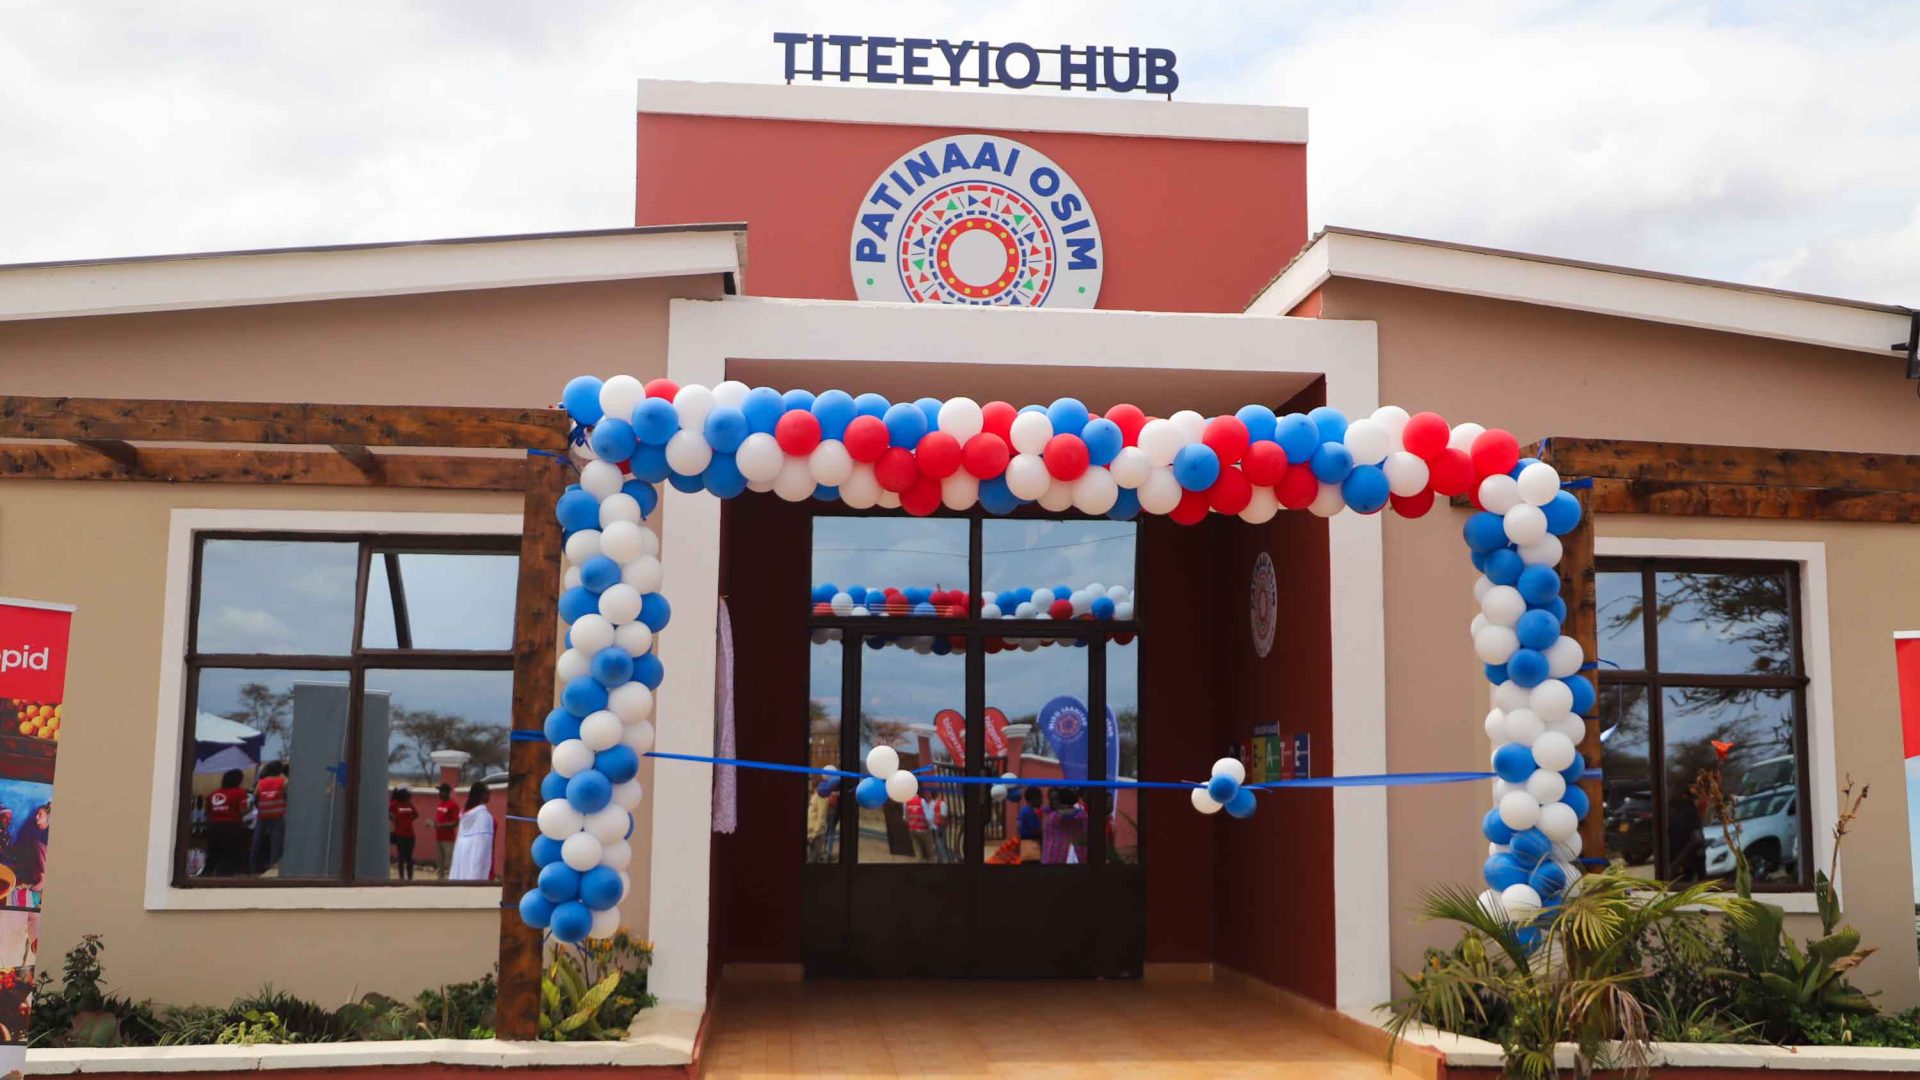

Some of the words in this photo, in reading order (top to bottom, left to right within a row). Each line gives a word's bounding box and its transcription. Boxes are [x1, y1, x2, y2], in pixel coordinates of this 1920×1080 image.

[773, 32, 1040, 89] TITEEYIO
[1060, 44, 1180, 94] HUB
[855, 141, 1021, 263] PATINAAI
[1029, 166, 1098, 271] OSIM
[0, 644, 49, 673] pid
